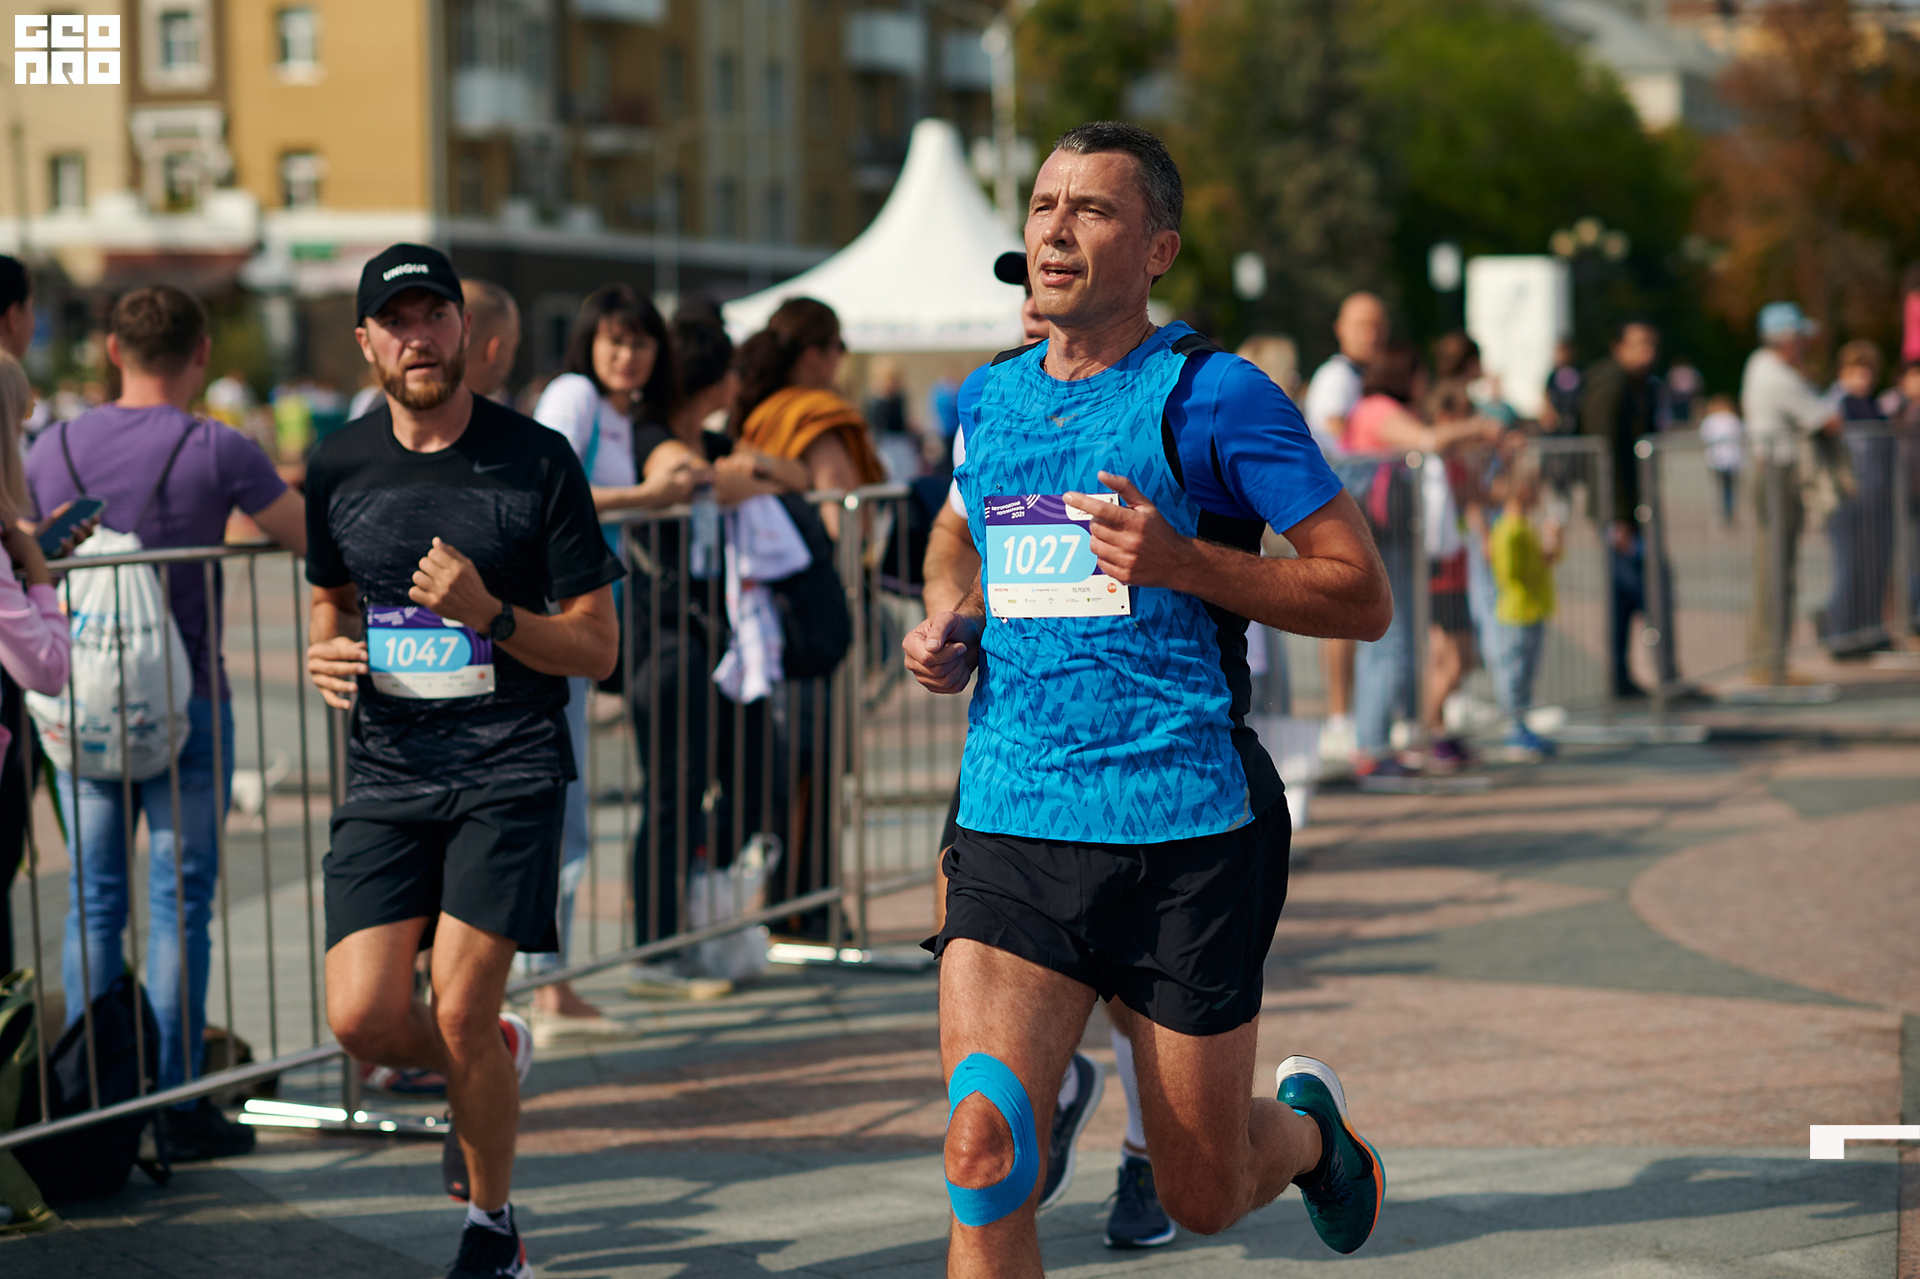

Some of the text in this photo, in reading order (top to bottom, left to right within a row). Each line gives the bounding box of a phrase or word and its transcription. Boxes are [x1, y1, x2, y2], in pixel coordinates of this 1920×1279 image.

[382, 263, 430, 281] UNIQUE
[1011, 511, 1025, 519] 2021
[1004, 535, 1081, 574] 1027
[385, 636, 459, 667] 1047
